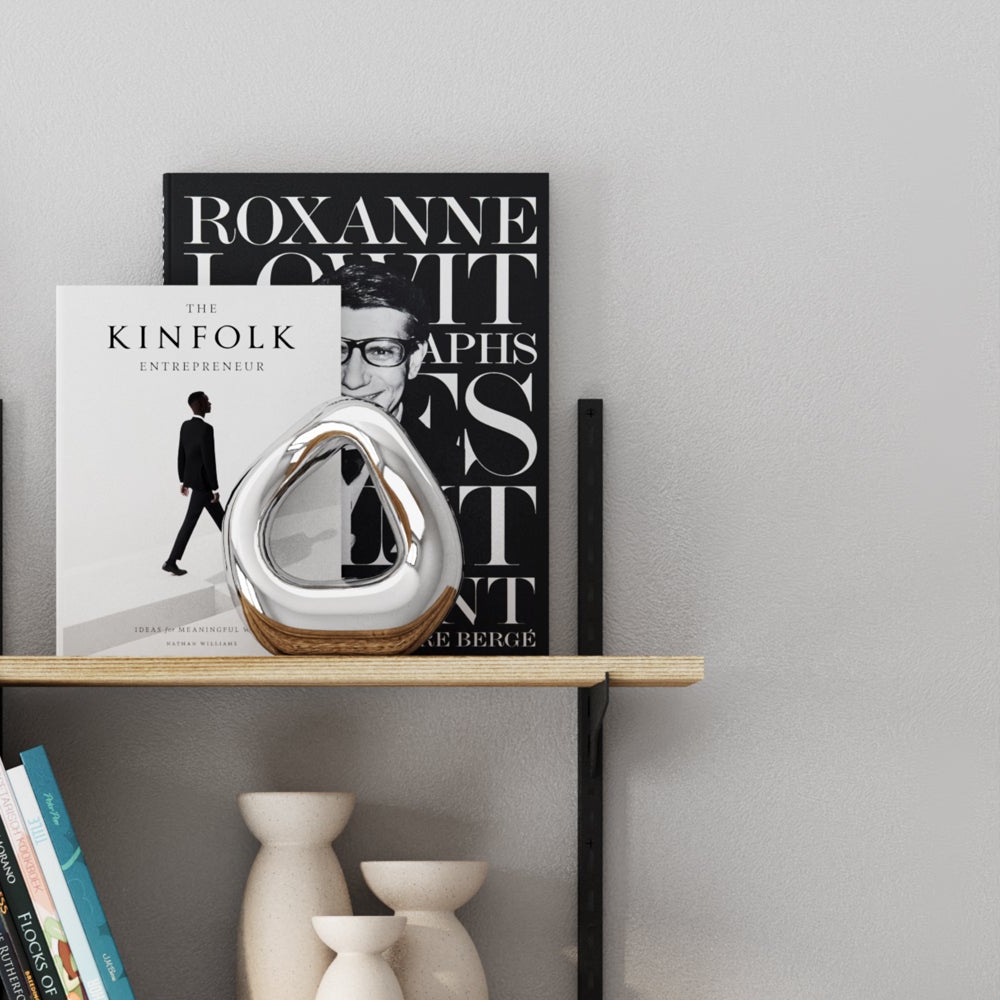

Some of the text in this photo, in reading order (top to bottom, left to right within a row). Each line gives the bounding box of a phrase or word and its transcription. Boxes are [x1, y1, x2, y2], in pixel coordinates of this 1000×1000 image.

[184, 195, 538, 246] ROXANNE
[186, 303, 218, 314] THE
[108, 324, 296, 350] KINFOLK
[139, 361, 265, 372] ENTREPRENEUR
[164, 626, 175, 634] for
[457, 628, 537, 648] BERGÉ
[16, 836, 44, 894] KOOKBOEK
[17, 911, 49, 972] FLOCKS
[39, 974, 57, 997] OF
